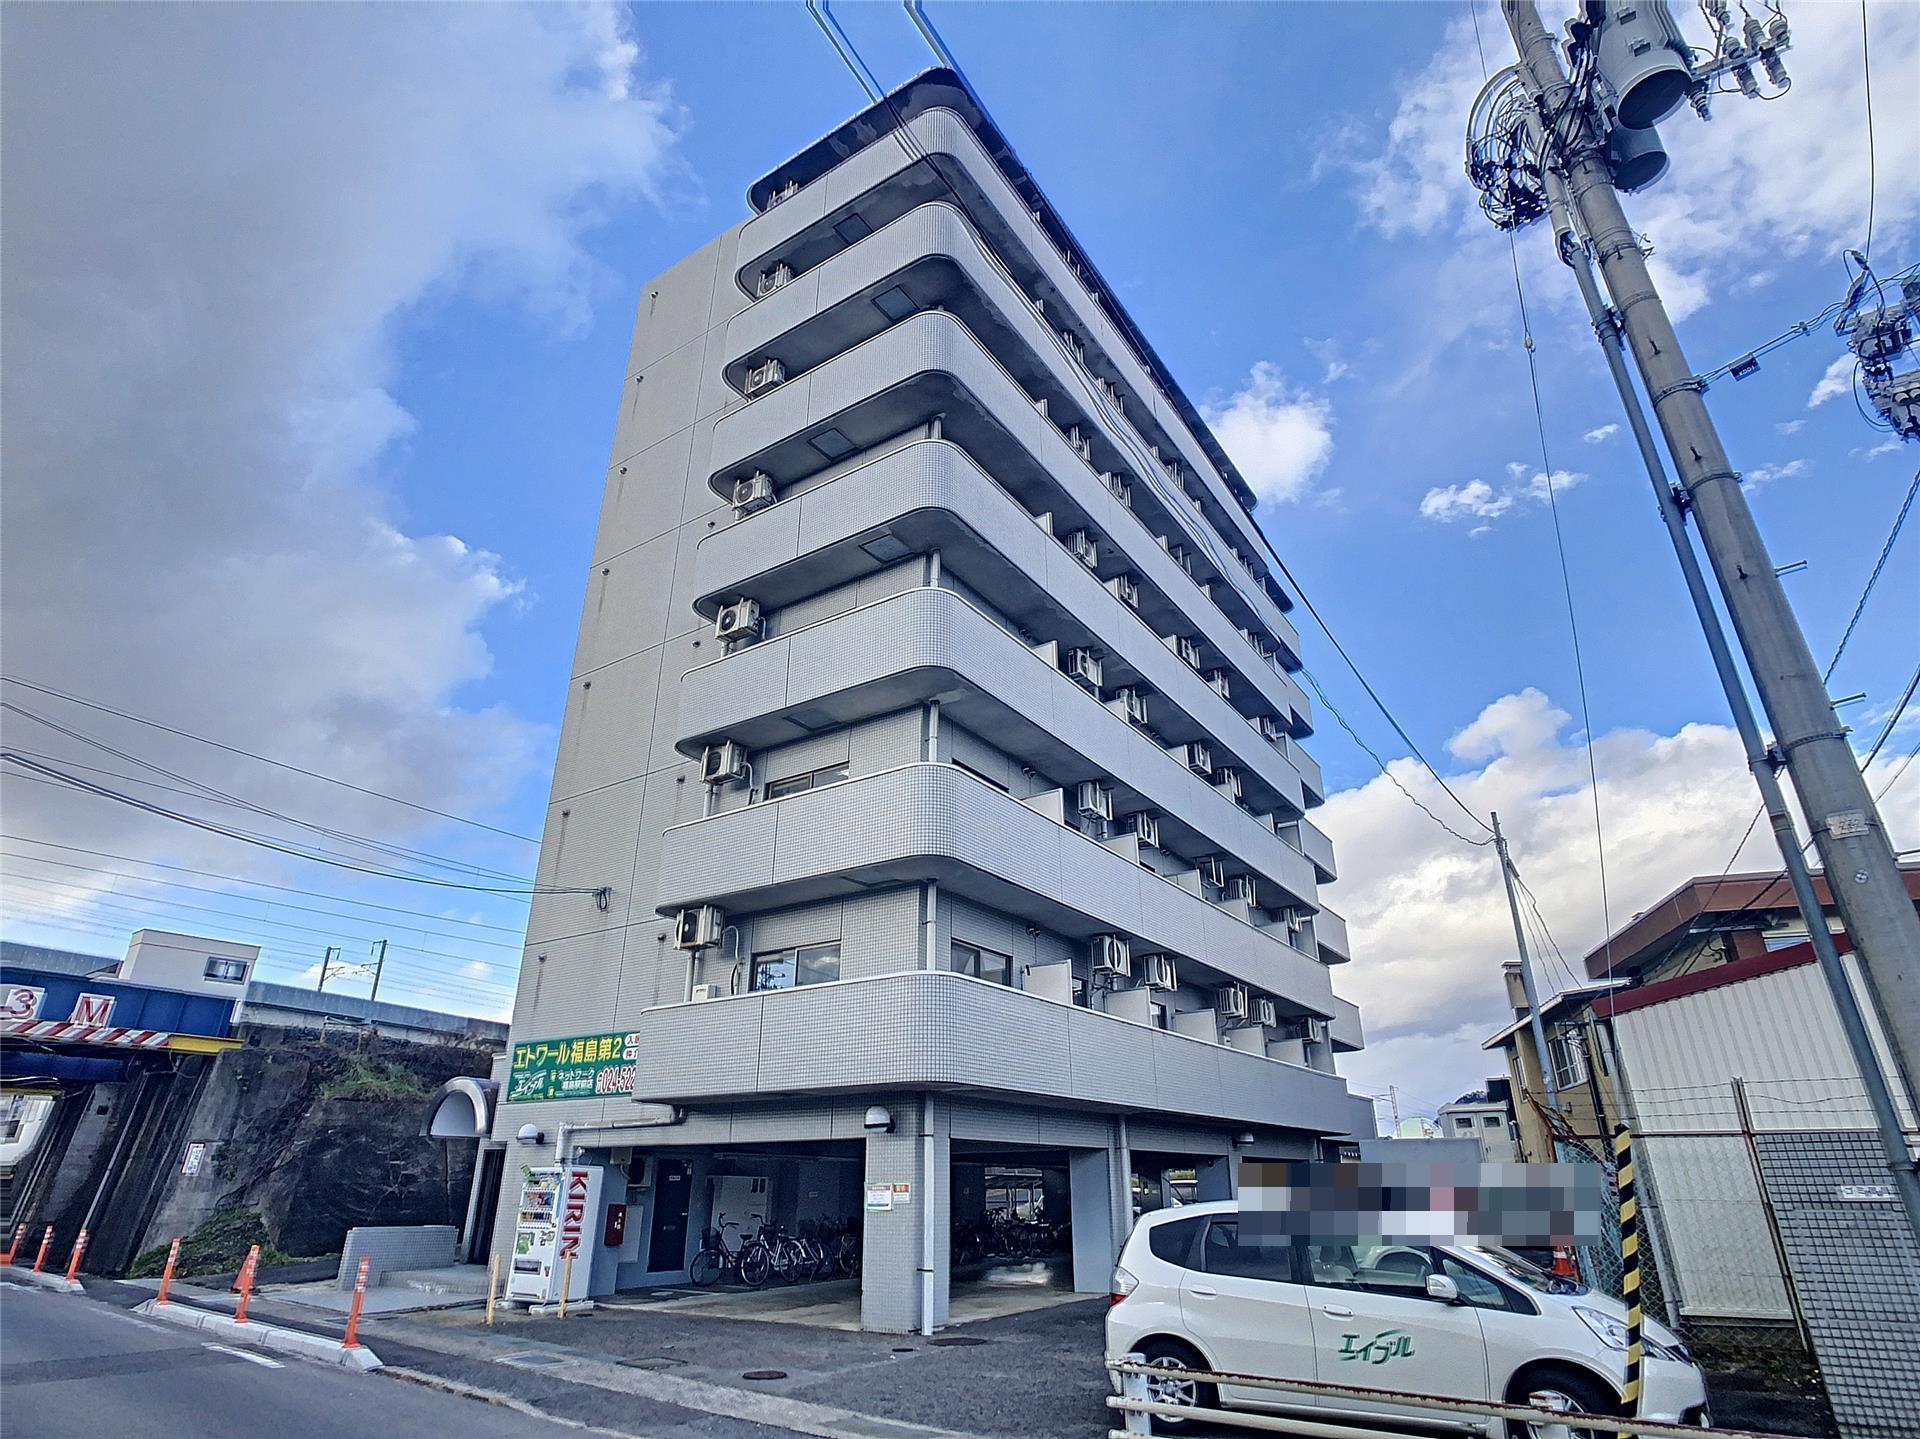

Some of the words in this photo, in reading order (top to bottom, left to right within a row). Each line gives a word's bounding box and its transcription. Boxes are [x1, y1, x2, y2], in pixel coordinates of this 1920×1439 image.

[75, 997, 112, 1025] M
[513, 1036, 622, 1069] エトワール福島第2
[558, 1068, 595, 1080] ネットワーク
[560, 1171, 588, 1258] KIRIN
[1338, 1330, 1415, 1364] エイブル
